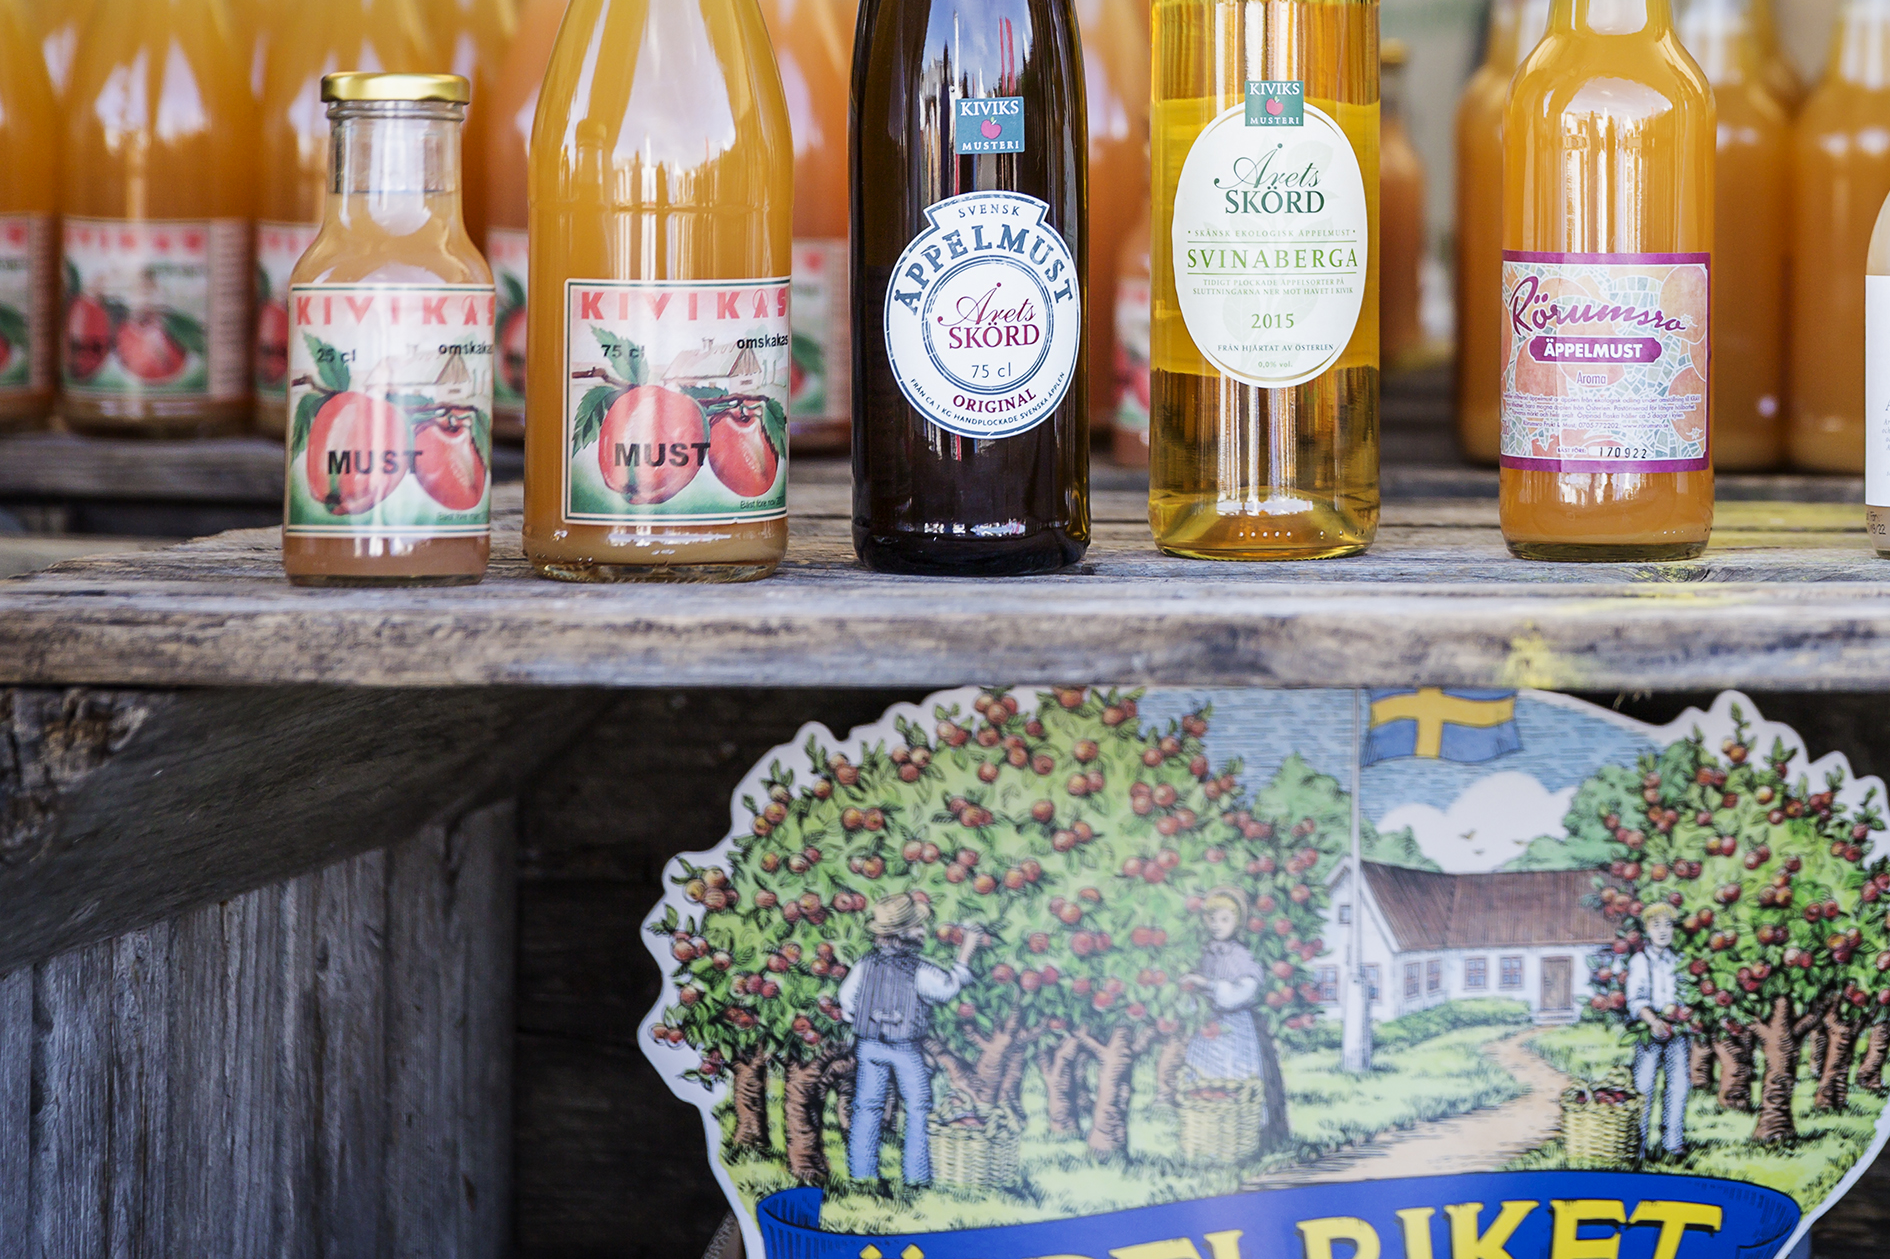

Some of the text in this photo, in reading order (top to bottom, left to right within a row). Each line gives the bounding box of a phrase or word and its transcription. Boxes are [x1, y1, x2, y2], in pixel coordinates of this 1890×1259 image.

[1249, 82, 1300, 96] KIVIKS
[960, 100, 1019, 117] KIVIKS
[1250, 117, 1300, 125] MUSTERI
[962, 140, 1019, 151] MUSTERI
[1213, 143, 1322, 190] Årets
[1225, 186, 1325, 214] SKÖRD
[958, 203, 1020, 219] SVENSK
[1194, 228, 1350, 238] SKÅNSK EKOLOGISK ÄPPELMUST
[1187, 248, 1358, 269] SVINABERGA
[894, 224, 1073, 316] ÄPPELMUST
[1281, 278, 1335, 286] ÄPPELSORTER
[1336, 276, 1345, 285] PÅ
[1304, 287, 1329, 295] HAVET
[937, 282, 1036, 326] Årets
[1509, 276, 1686, 336] Rörumsro
[1251, 312, 1295, 329] 2015
[949, 322, 1040, 350] SKÖRD
[317, 348, 356, 363] 25 cl
[601, 344, 645, 358] 75 cl
[1217, 343, 1239, 351] FRÅN
[1242, 344, 1279, 353] HJÄRTAT
[1295, 343, 1334, 351] ÖSTERLEN
[1544, 337, 1643, 359] ÄPPELMUST
[971, 362, 1012, 379] 75 cl
[1258, 360, 1293, 368] 0,0% vol.
[1576, 372, 1606, 385] Aroma
[911, 378, 926, 397] FRÅN
[925, 396, 935, 407] CA
[941, 408, 952, 418] KG
[954, 413, 1018, 427] HANDPLOCKADE
[1020, 397, 1048, 420] SVENSKA
[1047, 372, 1065, 399] ÄPPLEN
[953, 389, 1037, 414] ORIGINAL
[327, 450, 423, 475] MUST
[615, 443, 711, 466] MUST
